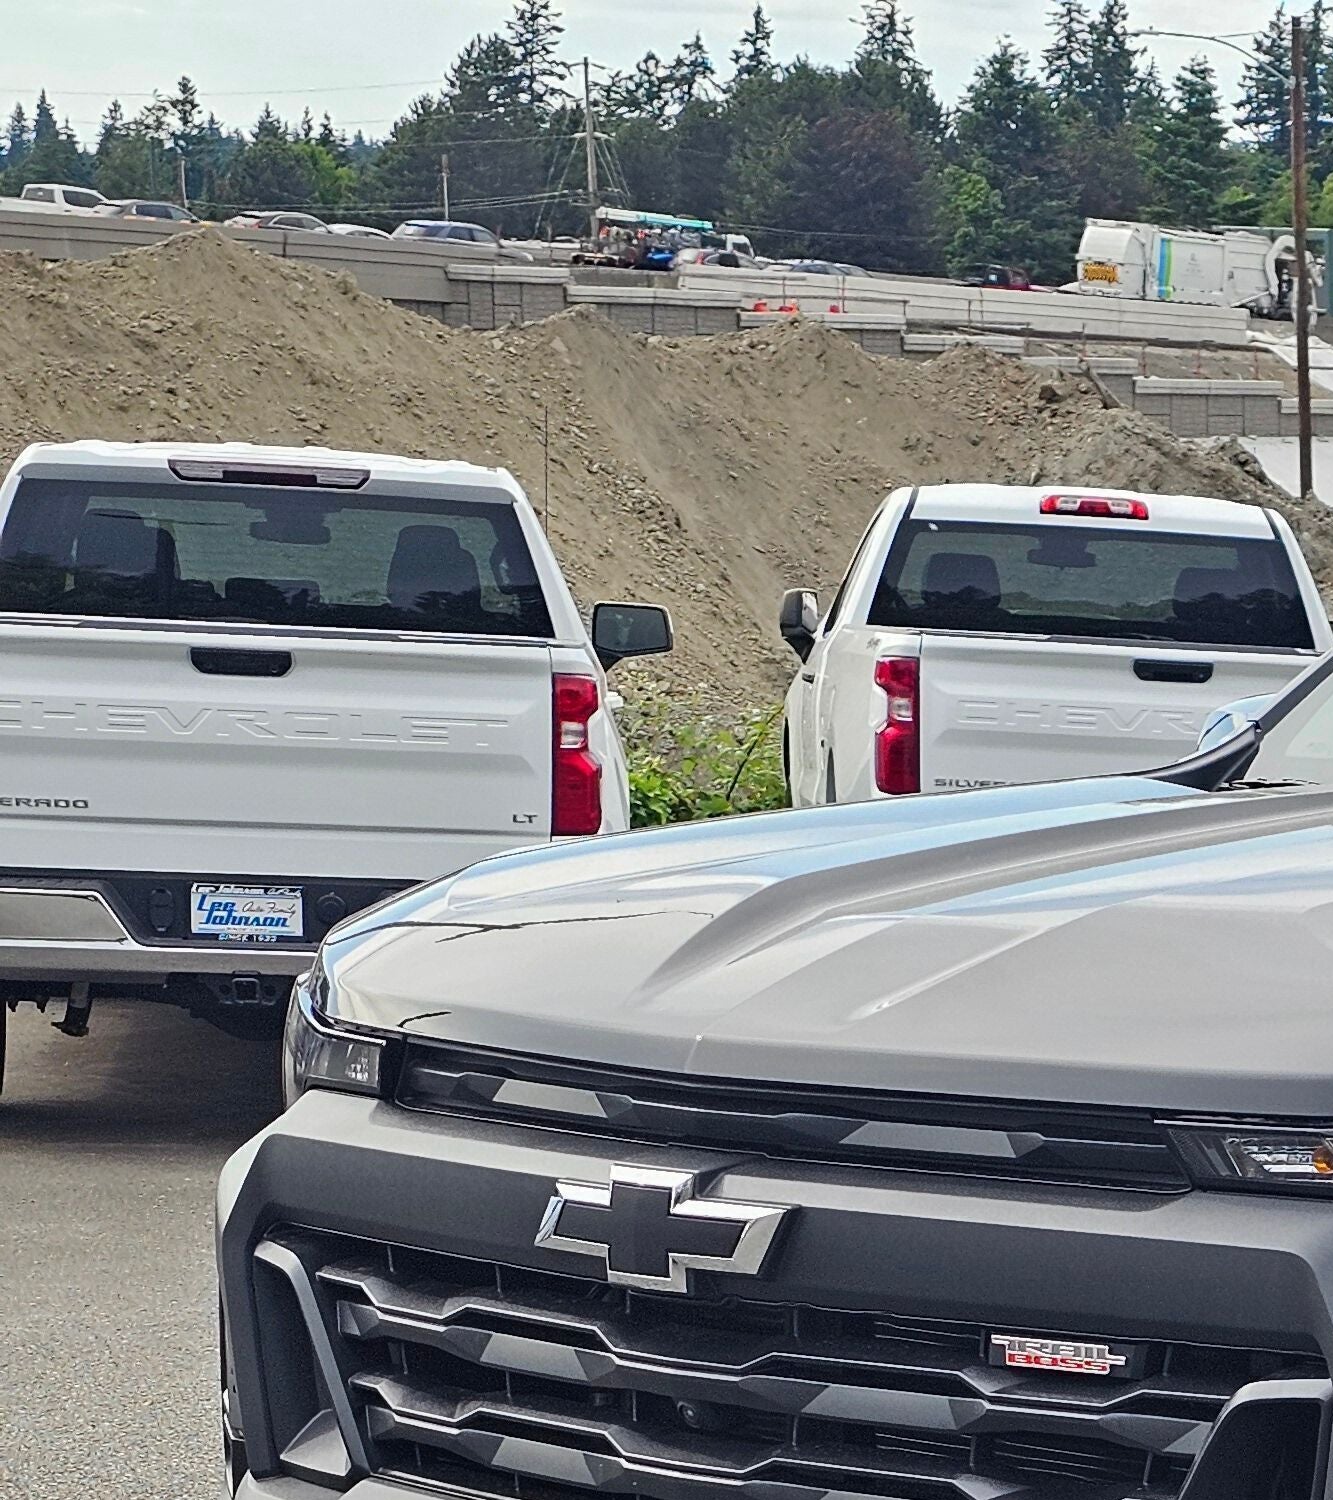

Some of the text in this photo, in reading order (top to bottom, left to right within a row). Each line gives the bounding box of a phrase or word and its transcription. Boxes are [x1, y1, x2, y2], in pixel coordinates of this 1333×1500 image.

[512, 814, 538, 824] LT
[991, 1334, 1126, 1366] TRAIL
[1006, 1350, 1110, 1375] BOSS
